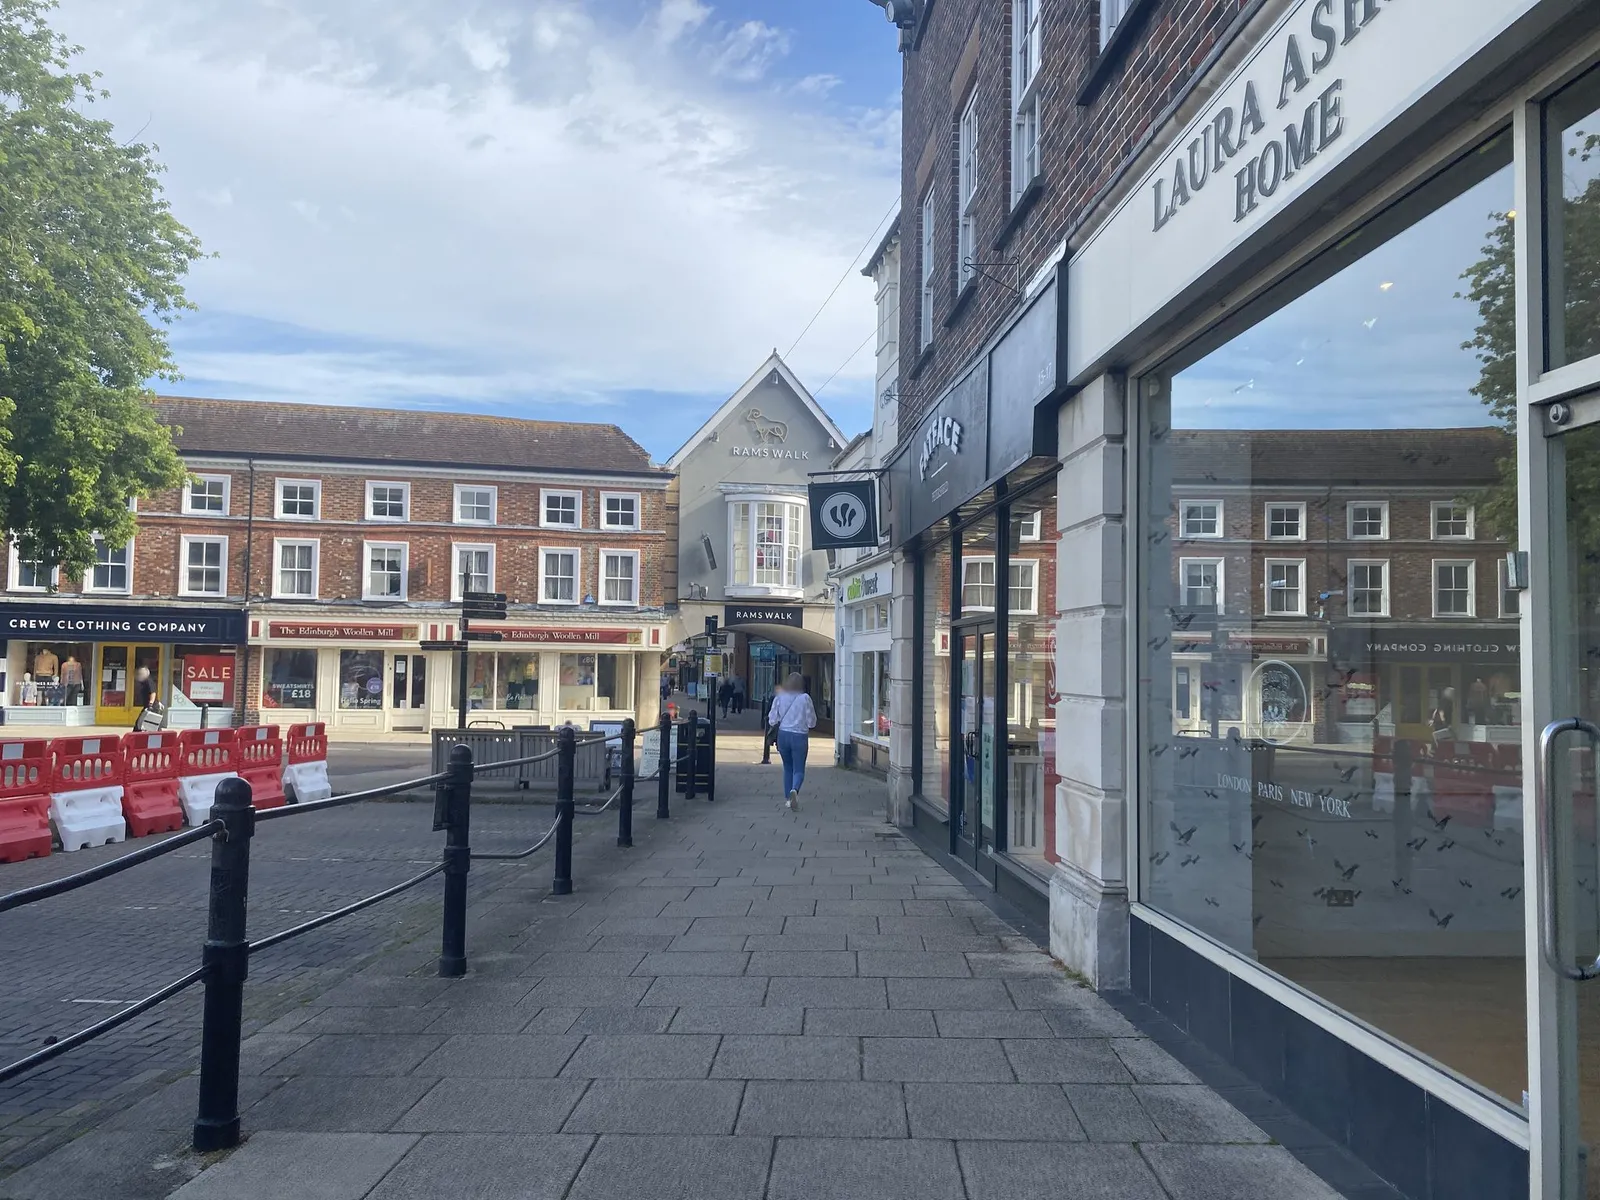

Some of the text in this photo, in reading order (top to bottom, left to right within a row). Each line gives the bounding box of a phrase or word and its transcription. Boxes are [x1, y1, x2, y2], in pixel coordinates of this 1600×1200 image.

[1152, 0, 1392, 232] LAURA ASH
[1233, 79, 1344, 223] HOME
[733, 446, 809, 460] RAMS WALK
[919, 416, 961, 483] FATFACE
[736, 611, 792, 620] RAMS WALK
[9, 619, 206, 632] CREW CLOTHING COMPANY
[280, 626, 394, 637] The Edinburgh Woollen Mill
[511, 631, 549, 640] Edinburgh
[552, 632, 581, 640] Woollen
[584, 632, 600, 640] Mill
[187, 666, 231, 679] SALE
[291, 689, 312, 699] £18
[360, 697, 382, 706] Spring
[1217, 772, 1351, 818] LONDON PARIS NEW YORK
